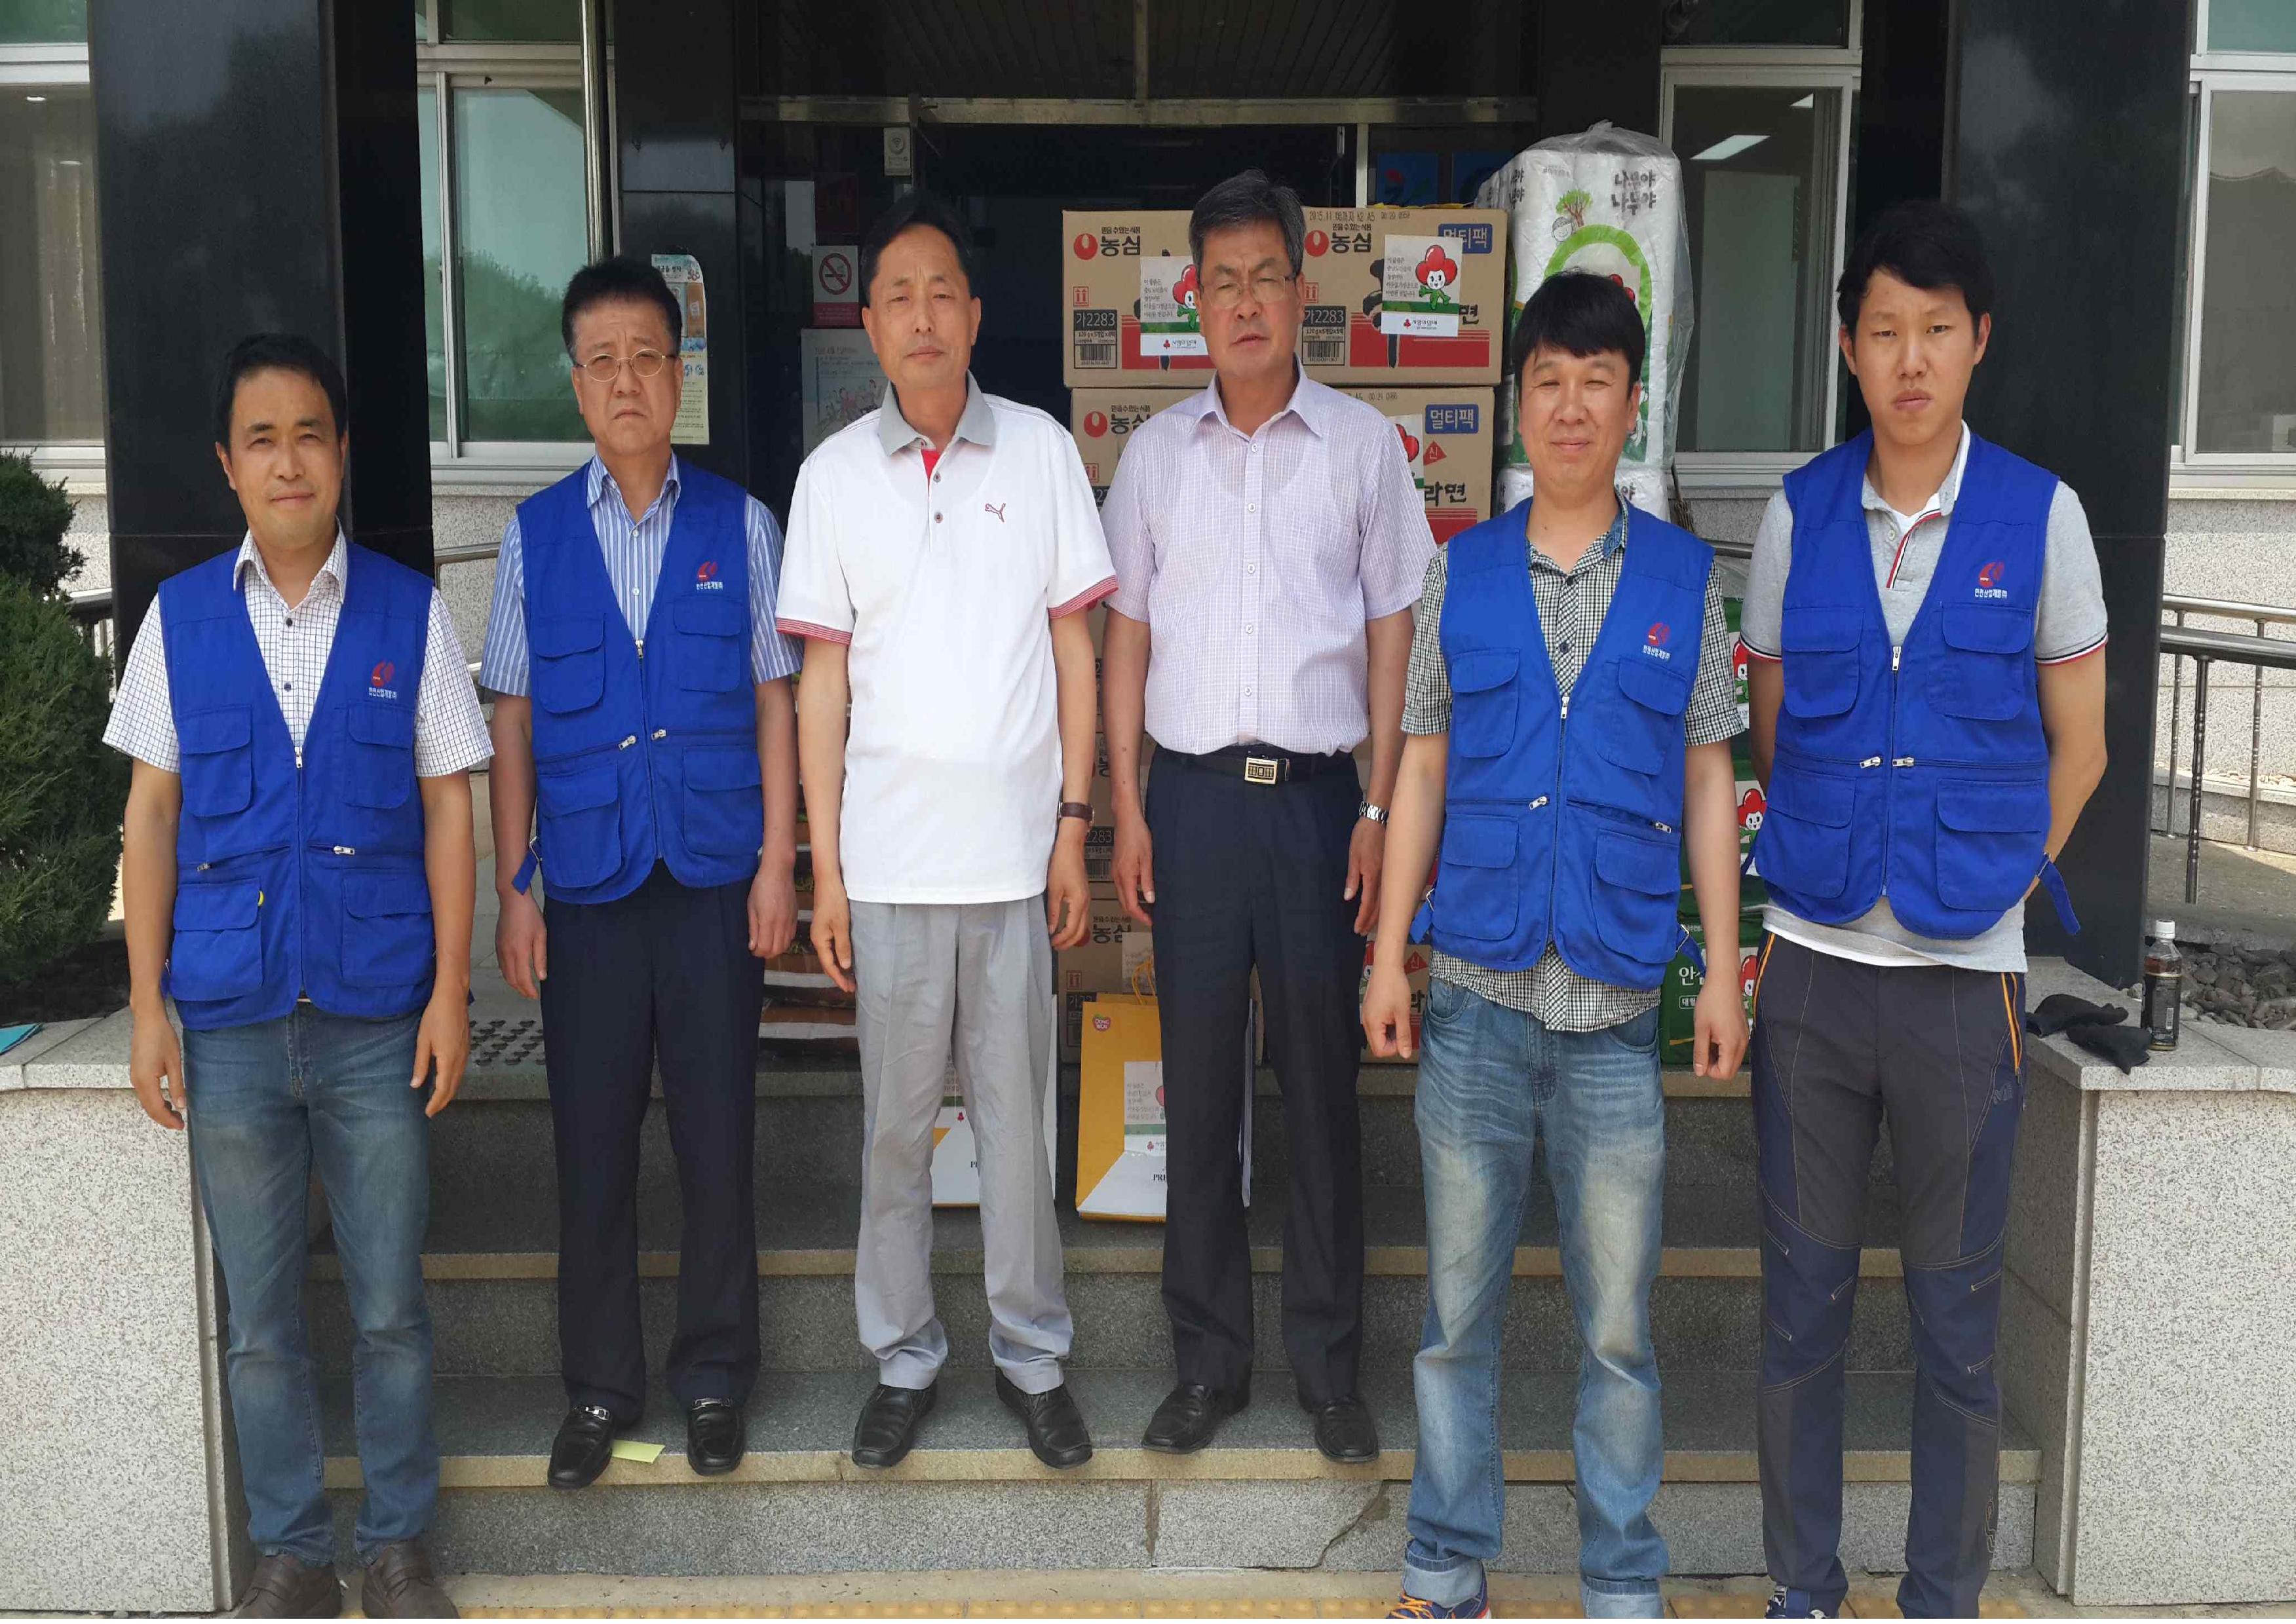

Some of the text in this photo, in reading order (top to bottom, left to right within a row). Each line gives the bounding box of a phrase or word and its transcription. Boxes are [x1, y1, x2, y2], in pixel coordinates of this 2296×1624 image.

[1100, 235, 1140, 256] 농심
[1331, 232, 1371, 254] 농심
[1077, 311, 1115, 328] 가2283
[1305, 309, 1344, 324] 가2283
[1430, 409, 1474, 430] 멀티팩
[1429, 446, 1438, 459] 신
[1424, 481, 1466, 507] 라면
[1092, 924, 1132, 943] 농심
